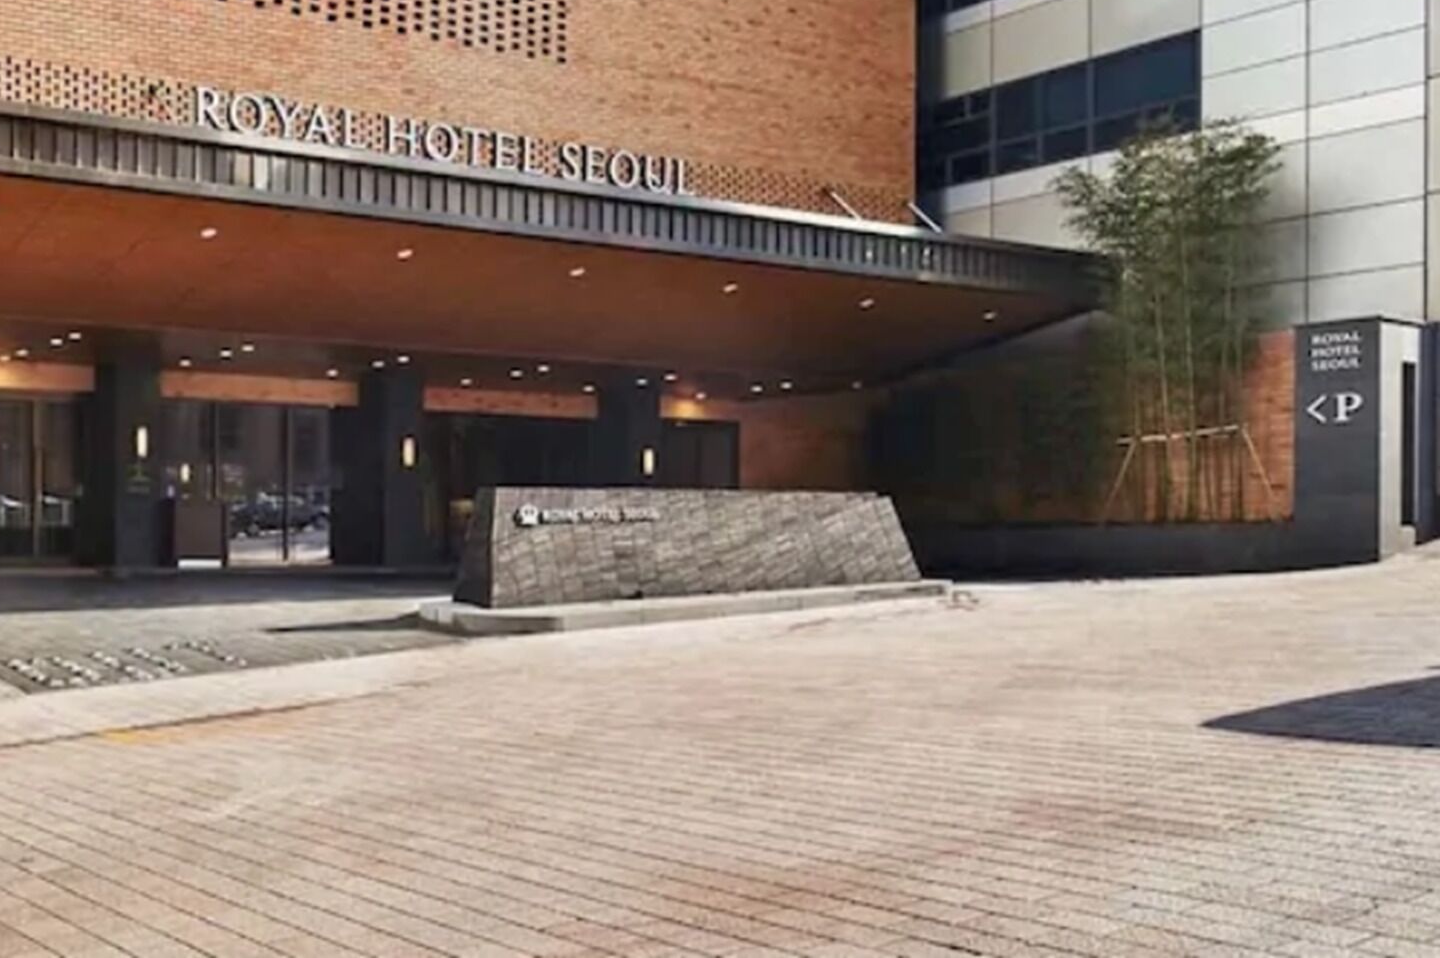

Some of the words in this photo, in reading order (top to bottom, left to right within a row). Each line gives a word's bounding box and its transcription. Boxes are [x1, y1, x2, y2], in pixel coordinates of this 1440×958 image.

[195, 85, 368, 149] ROYAL
[389, 115, 544, 174] HOTEL
[561, 142, 695, 196] SEOUL
[1312, 331, 1361, 344] ROYAL
[1312, 345, 1360, 358] HOTEL
[1312, 357, 1359, 371] SEOUL
[1335, 393, 1362, 422] P
